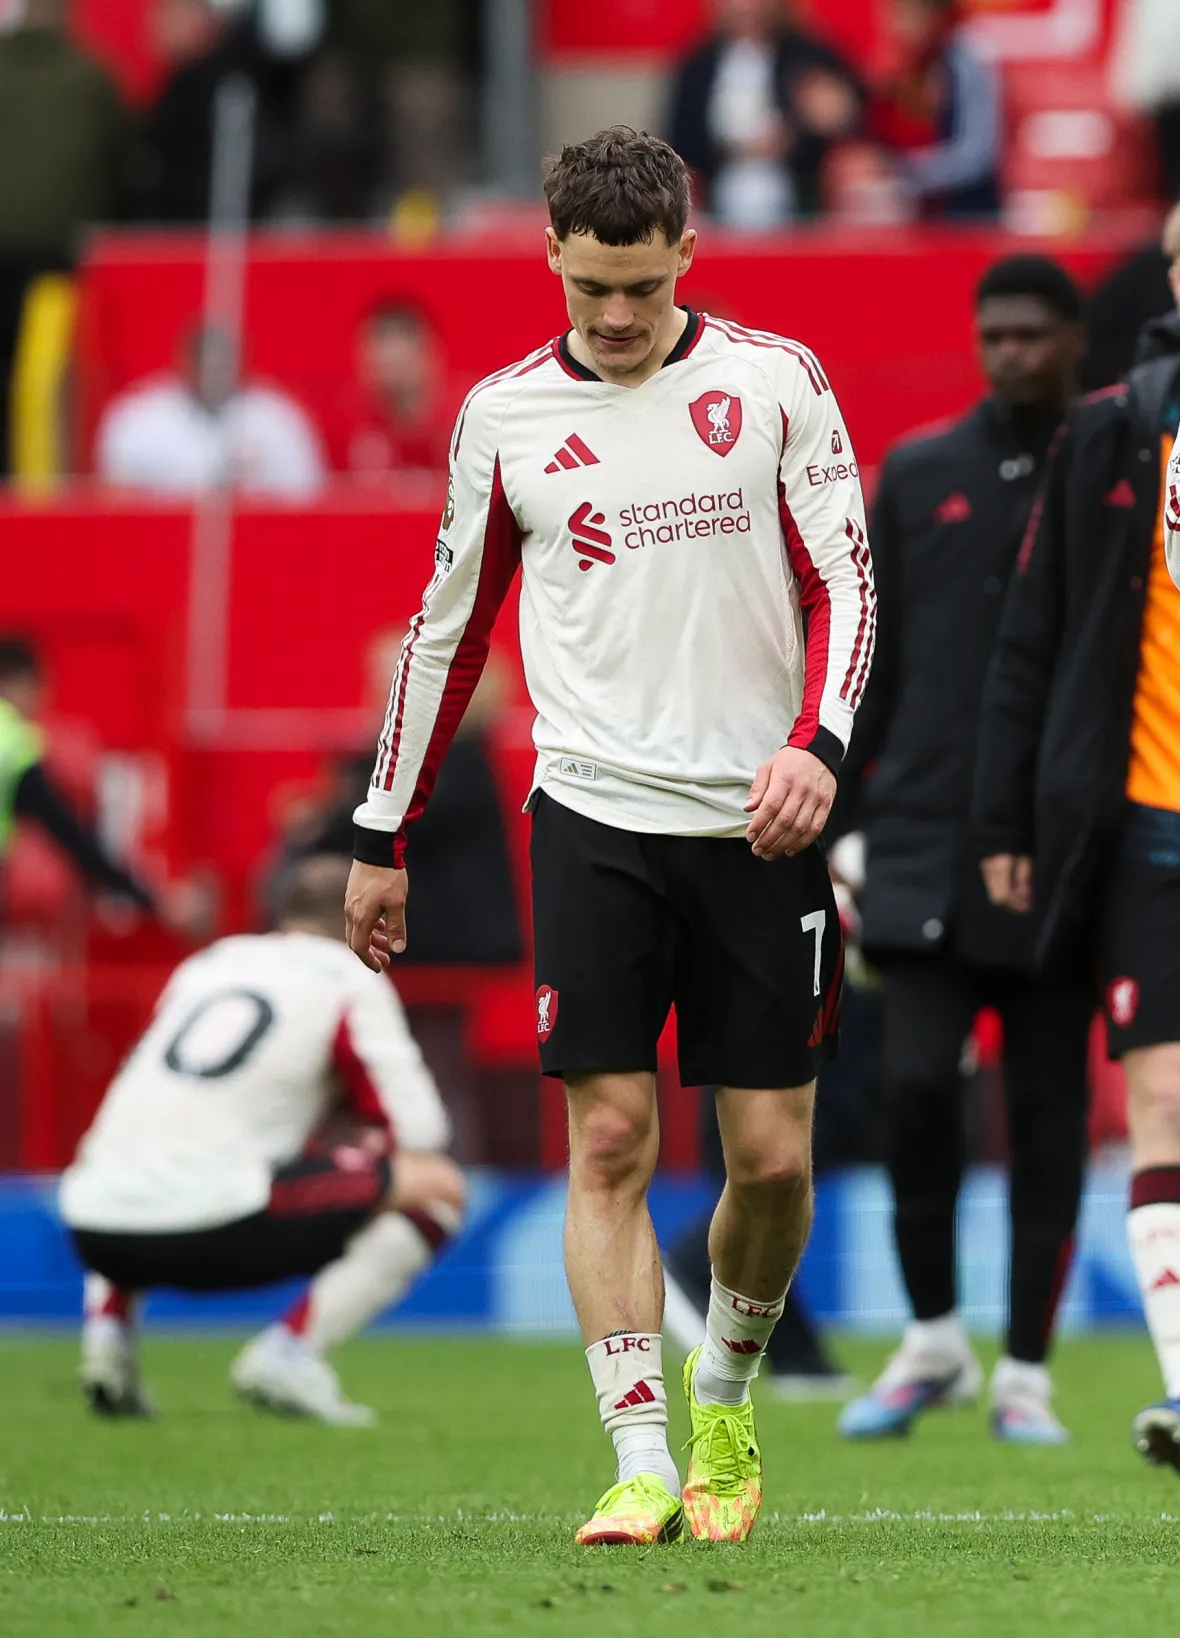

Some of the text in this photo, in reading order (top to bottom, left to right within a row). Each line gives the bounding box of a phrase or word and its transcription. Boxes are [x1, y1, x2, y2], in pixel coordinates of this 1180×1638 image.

[619, 487, 744, 527] standard
[624, 510, 752, 550] chartered
[800, 909, 826, 998] 7
[731, 1297, 778, 1318] LFC
[603, 1337, 651, 1357] LFC
